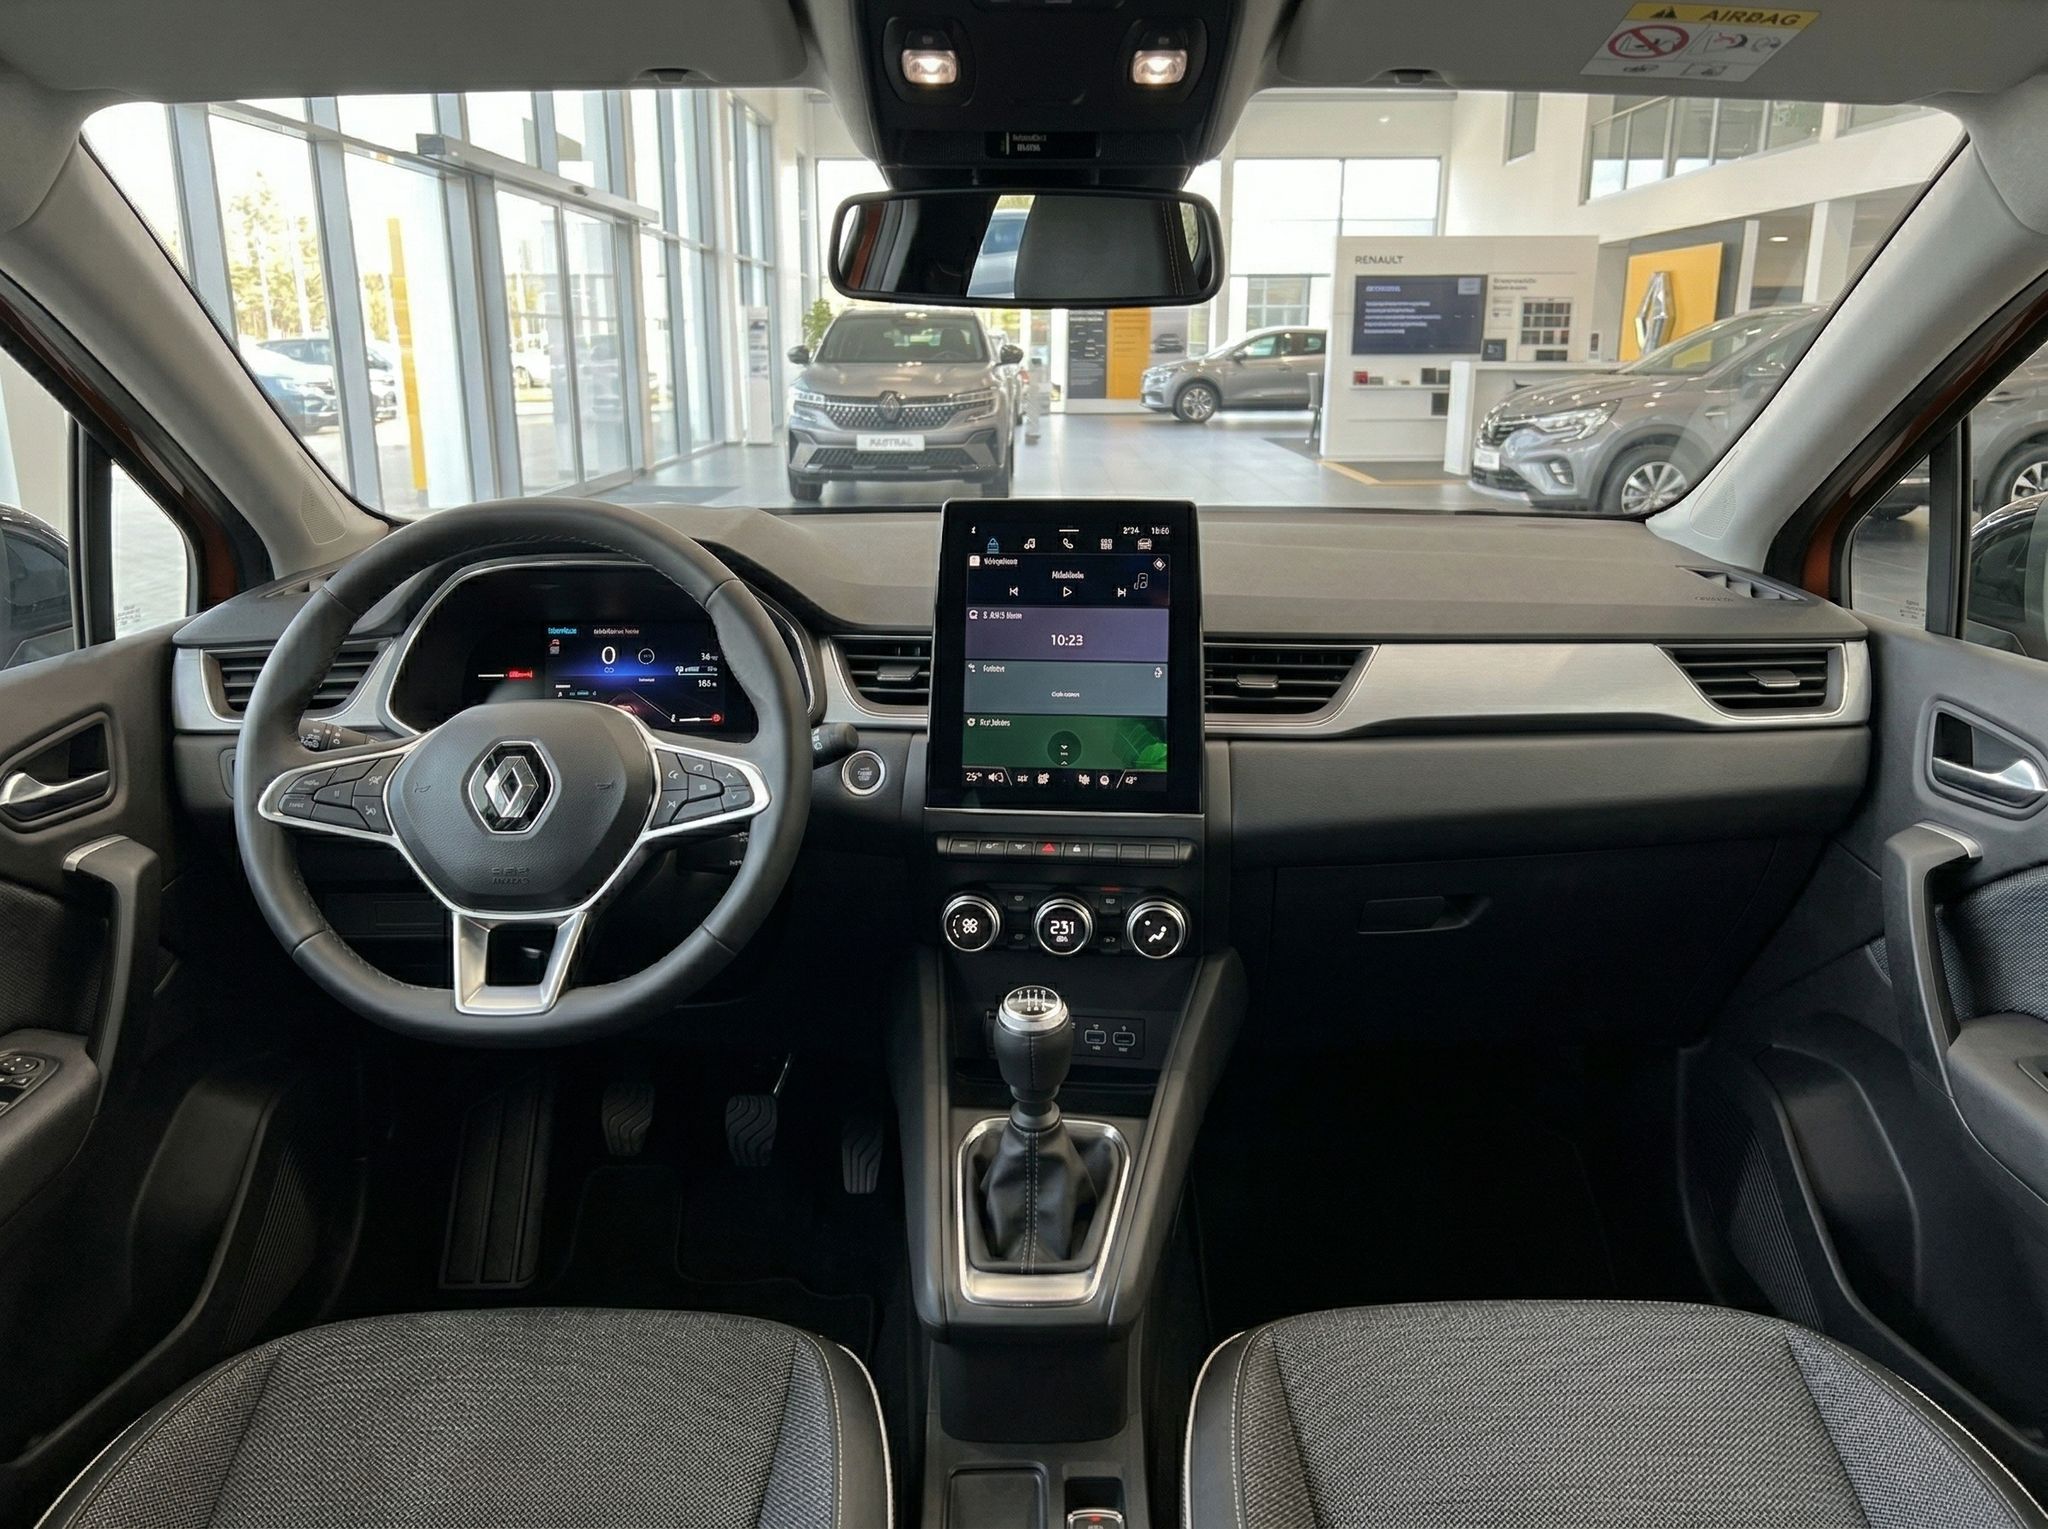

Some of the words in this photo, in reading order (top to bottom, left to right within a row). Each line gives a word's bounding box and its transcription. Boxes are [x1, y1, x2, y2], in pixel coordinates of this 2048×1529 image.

[1700, 9, 1801, 26] AIRBAG
[1355, 255, 1404, 265] RENAULT
[1051, 634, 1084, 646] 10:23
[601, 646, 616, 665] 0
